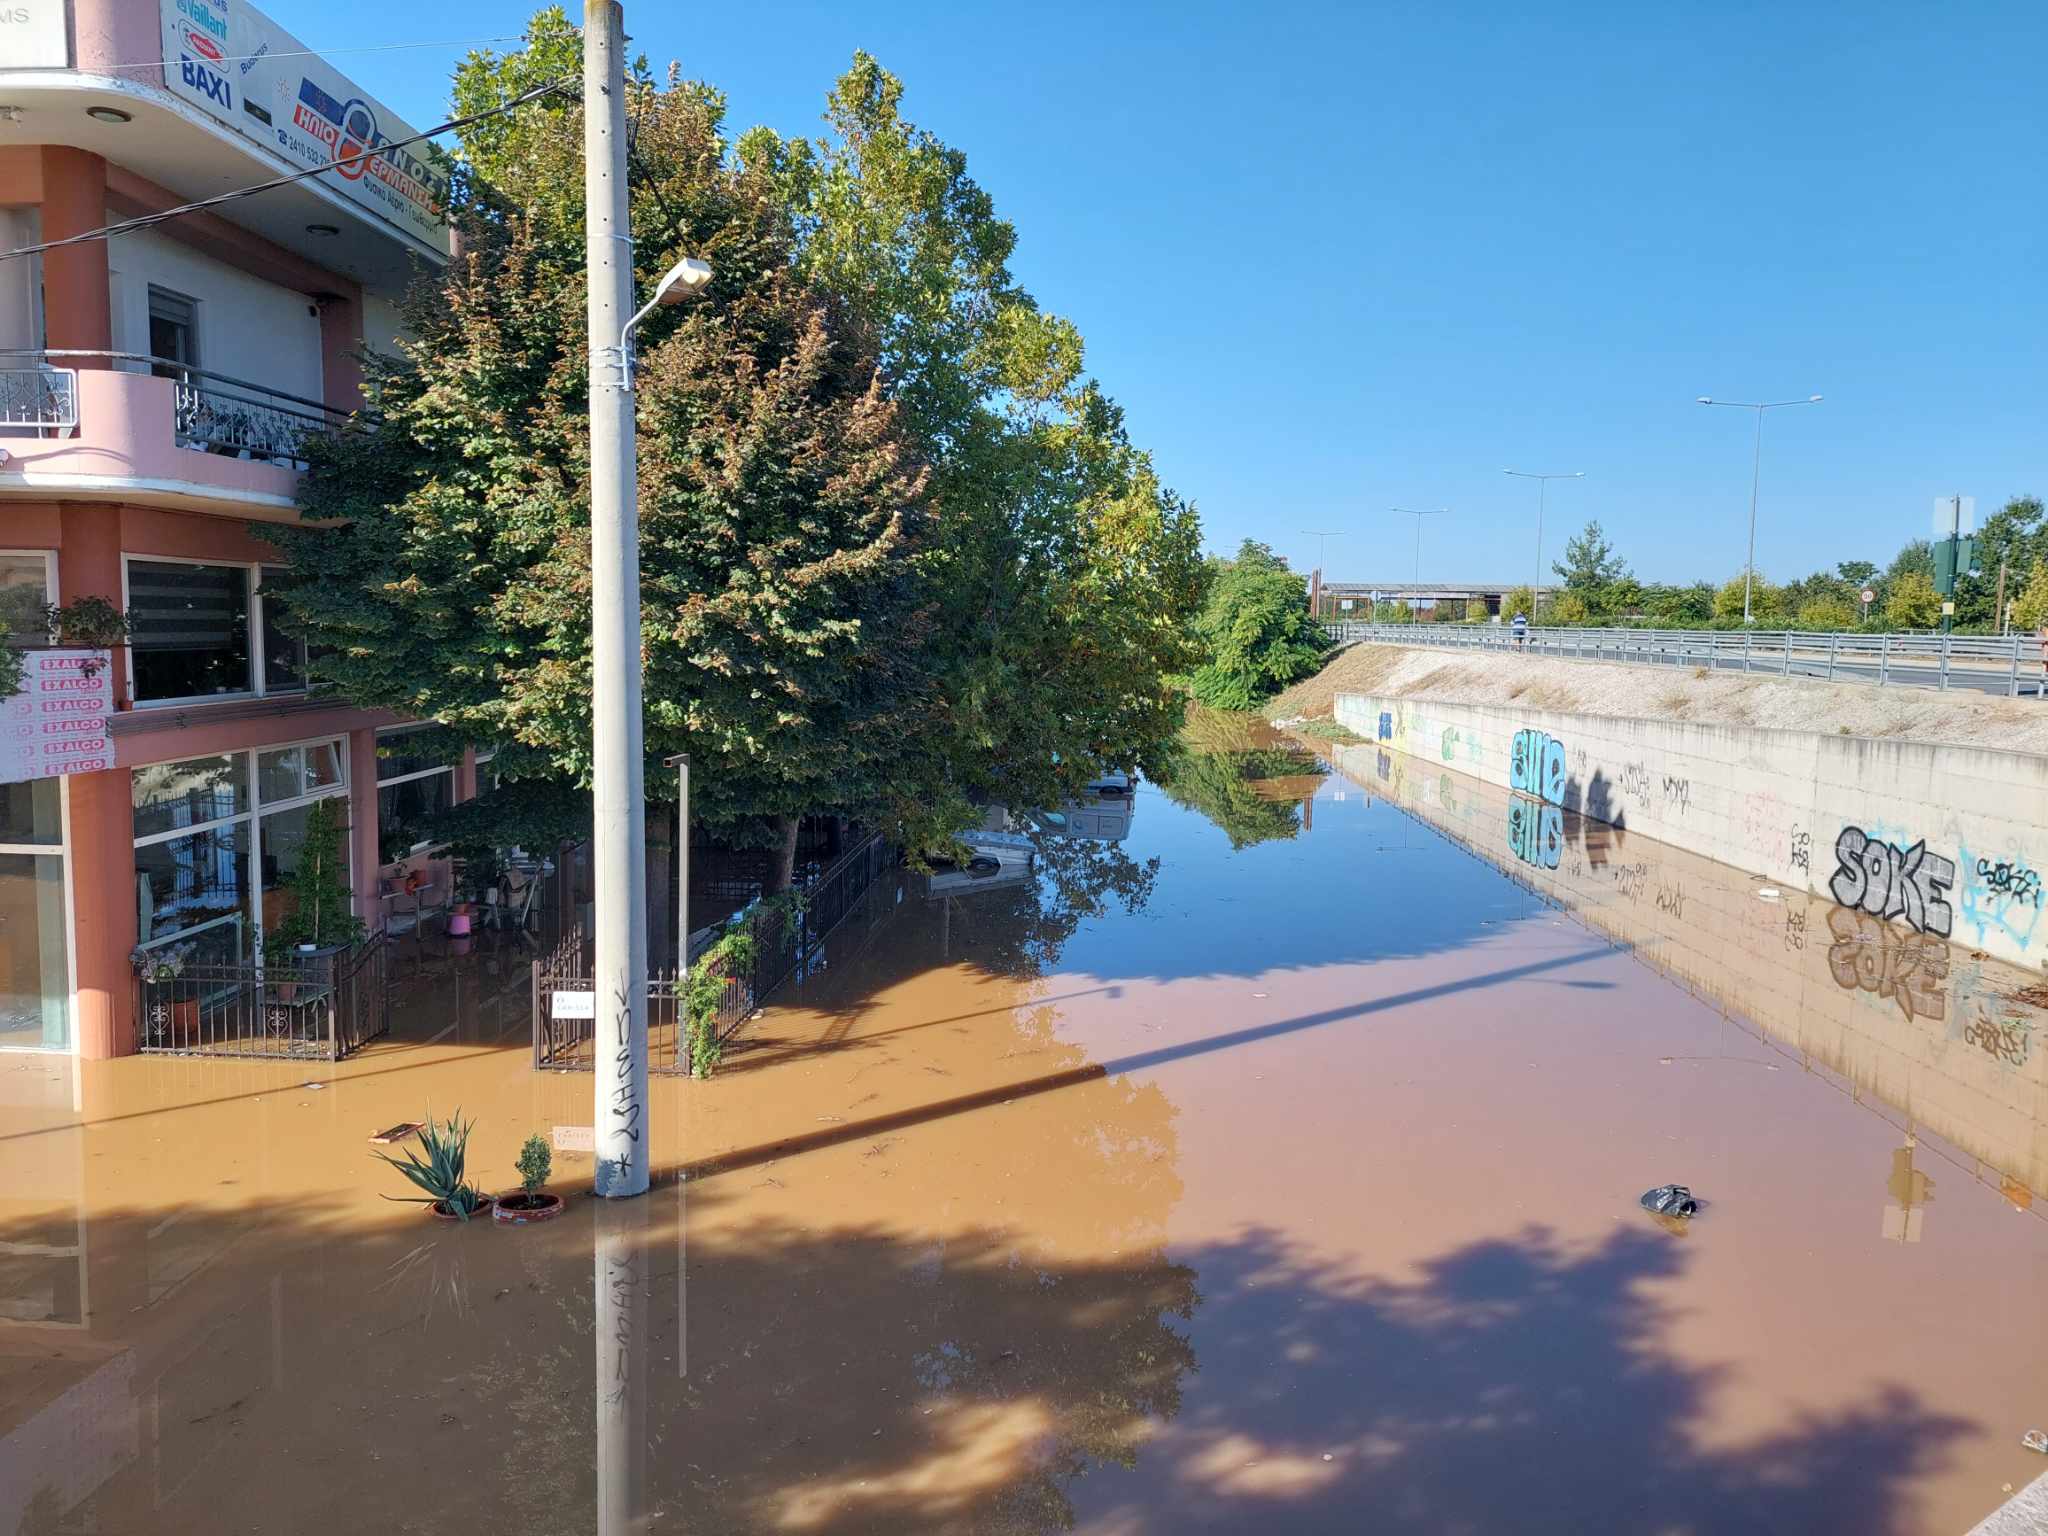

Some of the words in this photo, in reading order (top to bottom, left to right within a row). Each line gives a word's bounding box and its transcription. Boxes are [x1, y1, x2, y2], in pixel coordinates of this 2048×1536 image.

[188, 0, 228, 40] Vaillant
[181, 52, 232, 110] BAXI
[45, 679, 99, 690] EXALCO
[46, 700, 101, 711] EXALCO
[47, 719, 101, 733] EXALCO
[48, 740, 101, 753] EXALCO
[1829, 826, 1955, 938] SOKE
